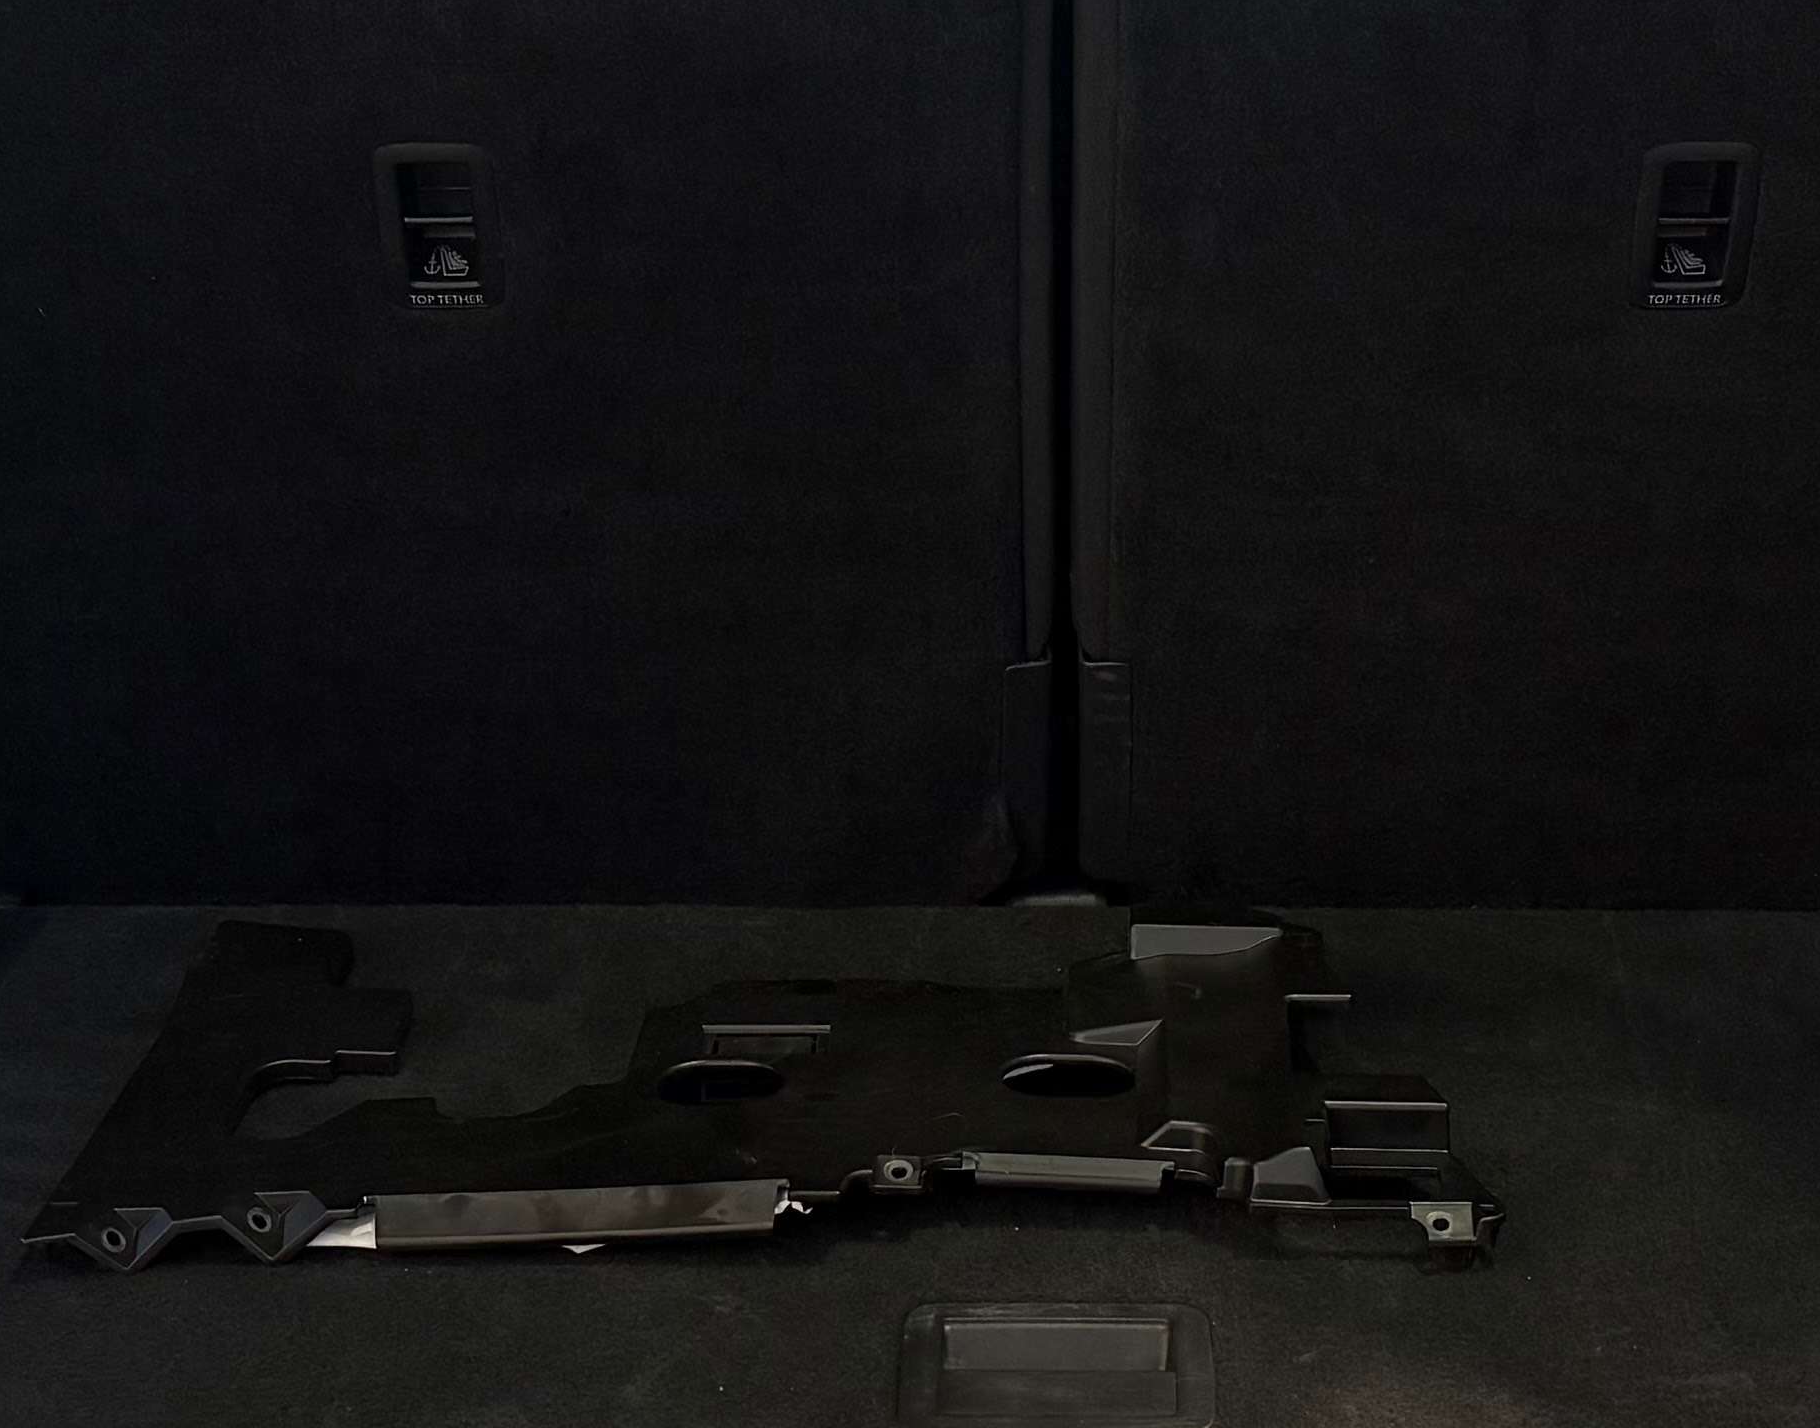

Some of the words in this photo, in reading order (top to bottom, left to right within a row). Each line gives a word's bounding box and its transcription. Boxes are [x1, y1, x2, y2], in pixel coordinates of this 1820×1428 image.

[409, 294, 435, 305] TOP
[437, 294, 485, 305] TETHER
[1648, 294, 1673, 305] TOP
[1675, 294, 1722, 305] TETHER
